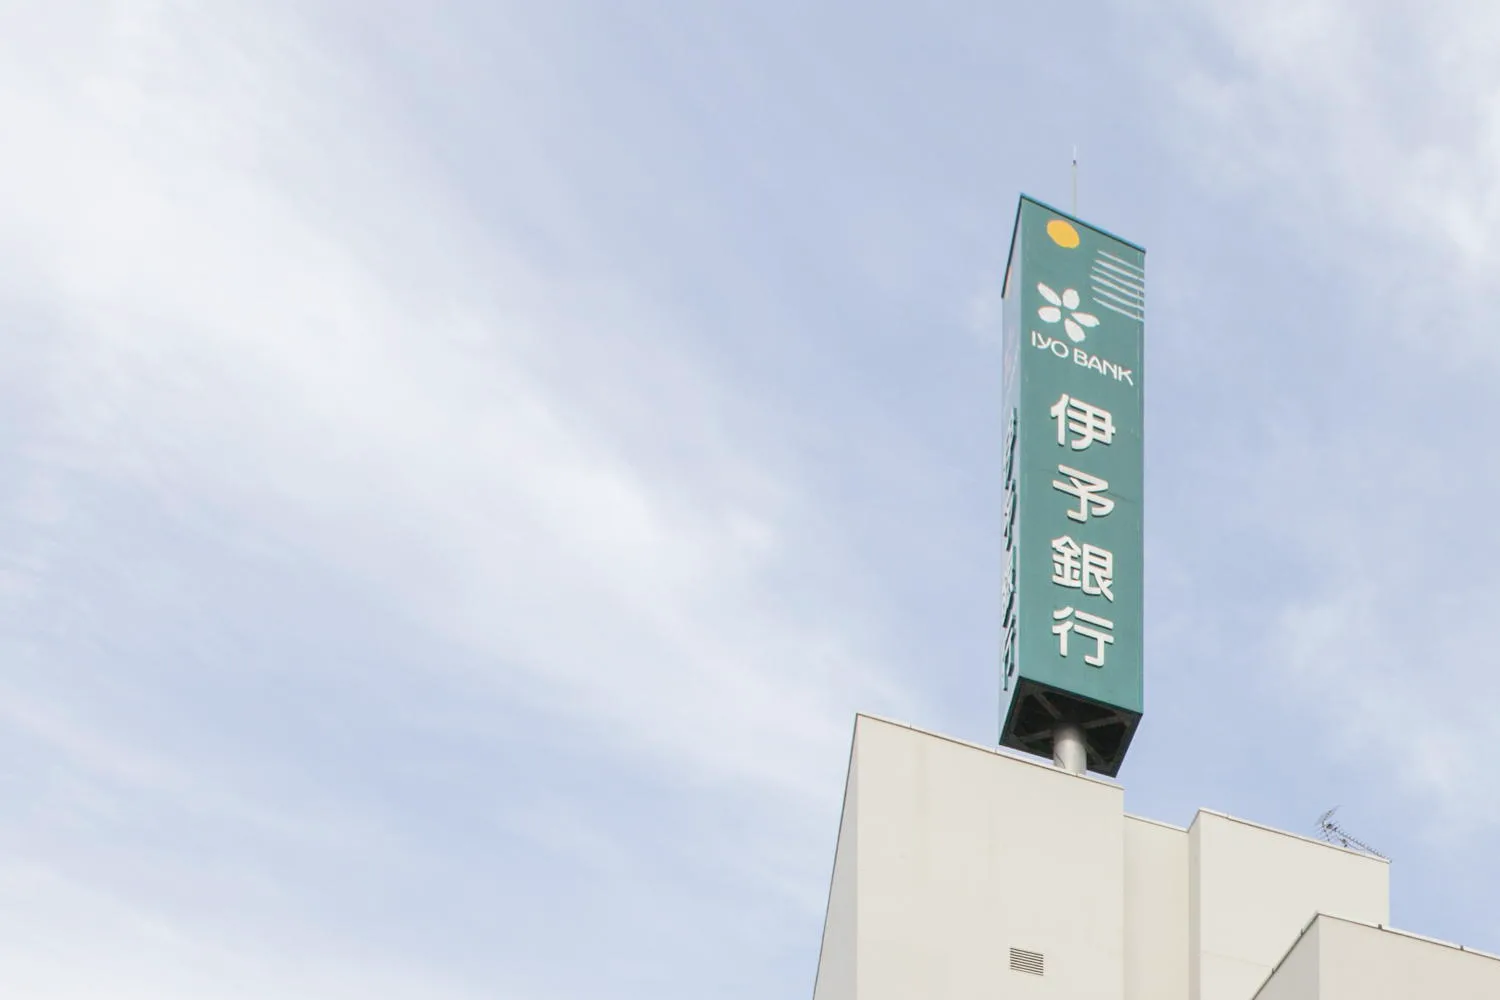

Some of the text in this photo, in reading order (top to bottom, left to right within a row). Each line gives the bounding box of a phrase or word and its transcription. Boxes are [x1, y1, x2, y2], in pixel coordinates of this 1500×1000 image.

[1031, 330, 1134, 386] IYO BANK
[1050, 393, 1116, 668] 伊予銀行
